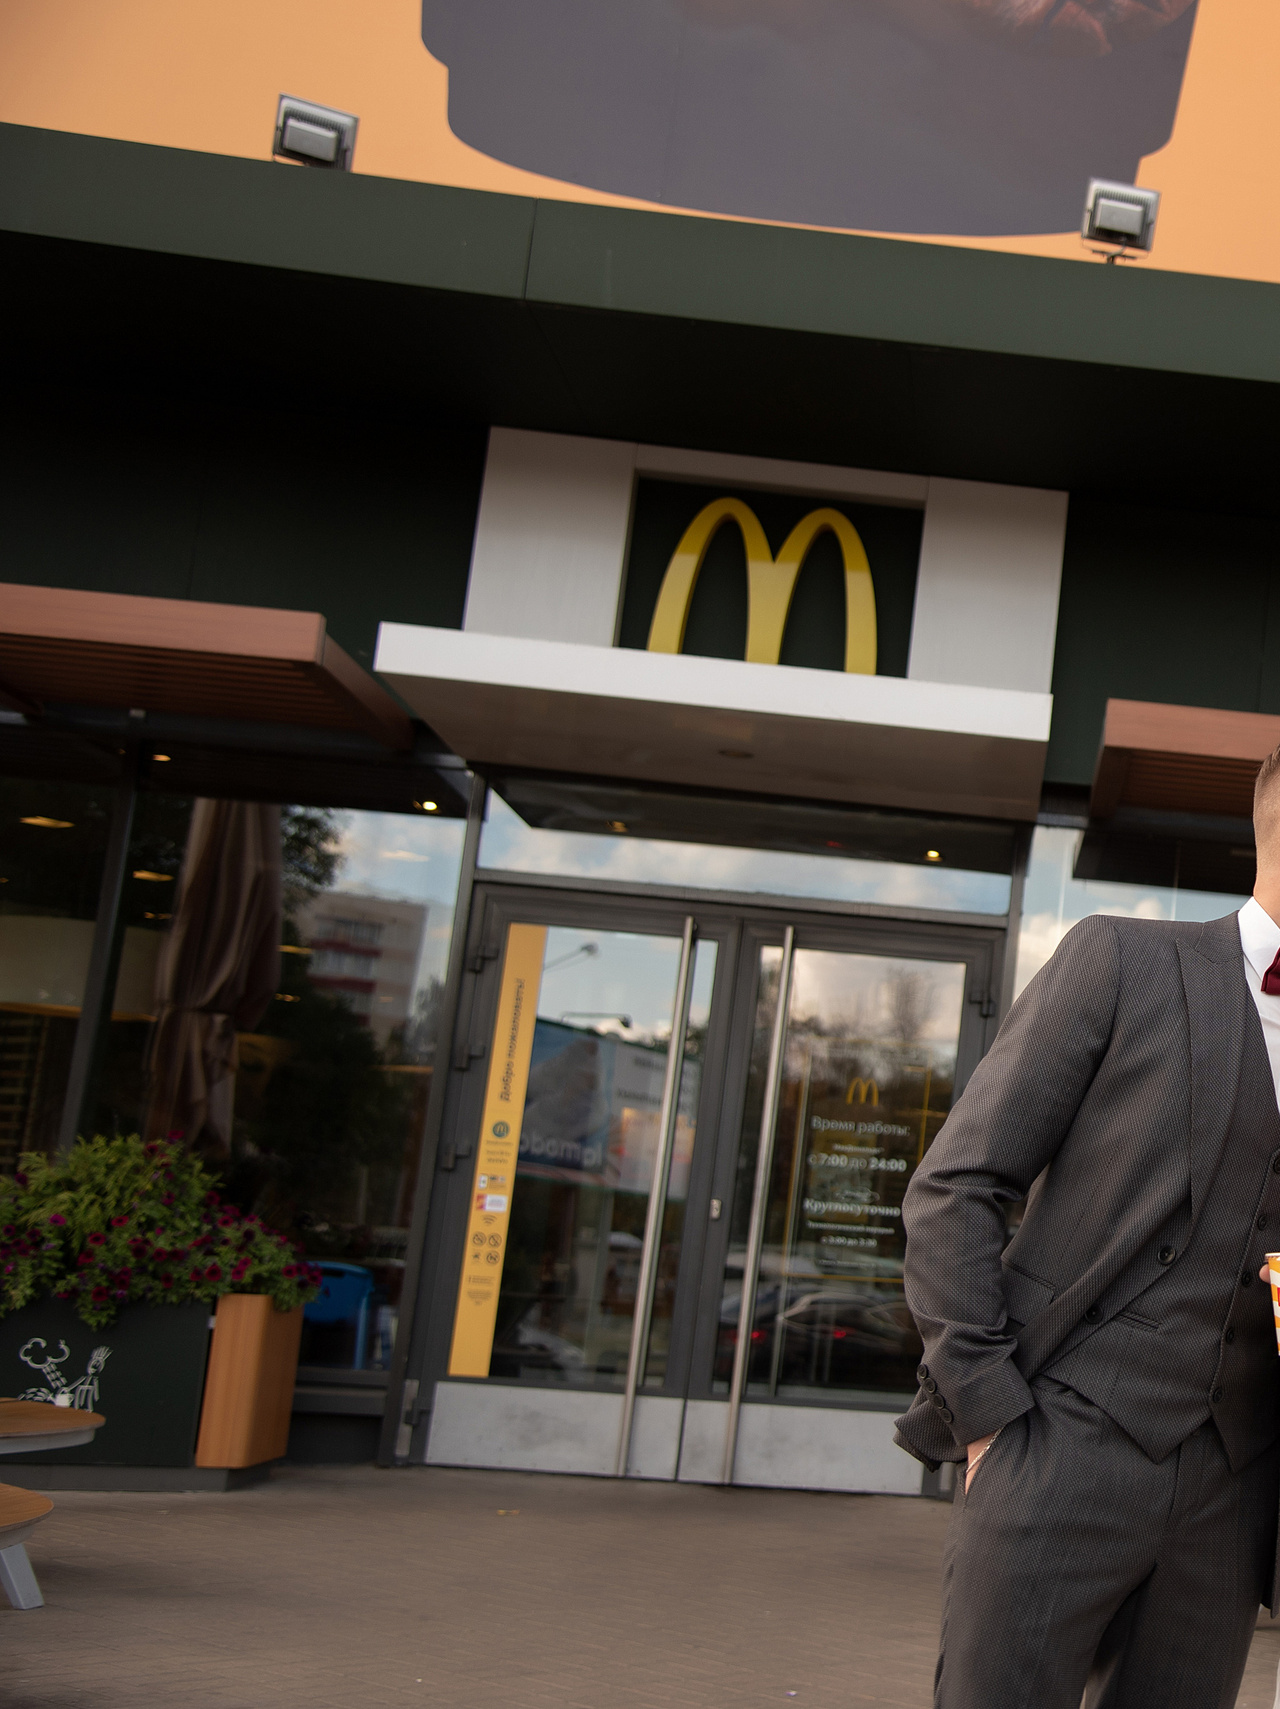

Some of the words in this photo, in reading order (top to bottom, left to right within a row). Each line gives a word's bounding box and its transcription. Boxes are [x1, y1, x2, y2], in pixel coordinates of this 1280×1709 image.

[811, 1115, 856, 1132] Время
[819, 1153, 848, 1168] 7:00
[849, 1158, 866, 1170] до
[869, 1157, 907, 1173] 24:00
[803, 1198, 901, 1217] Круглосуточно
